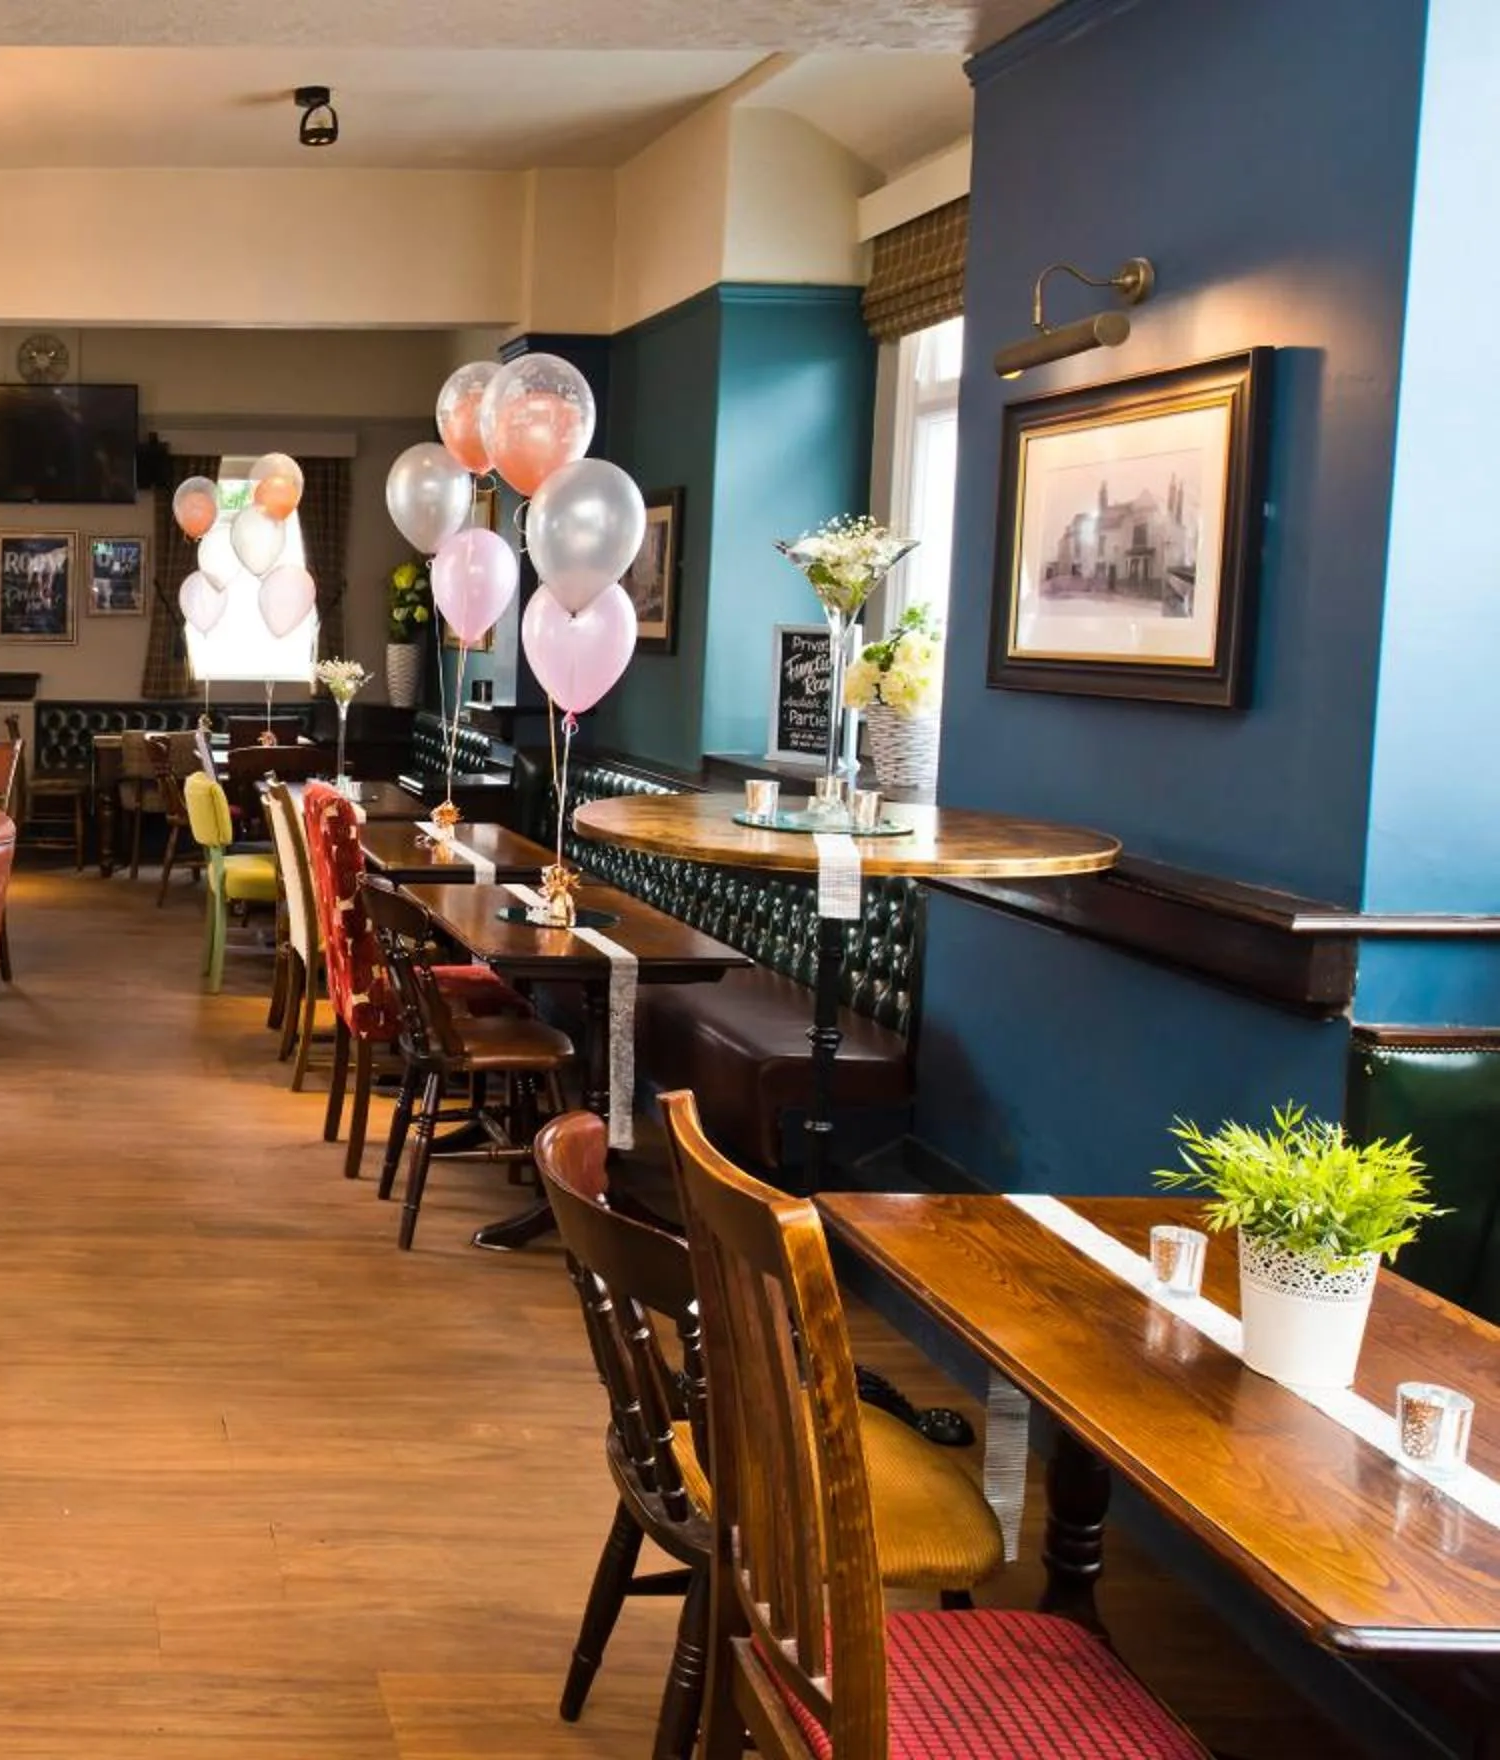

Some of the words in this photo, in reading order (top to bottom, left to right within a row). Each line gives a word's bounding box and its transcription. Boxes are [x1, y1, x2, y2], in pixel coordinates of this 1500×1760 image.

[791, 634, 830, 653] Privat
[784, 653, 832, 683] Functio
[802, 676, 831, 695] Roo
[789, 709, 828, 727] Partie
